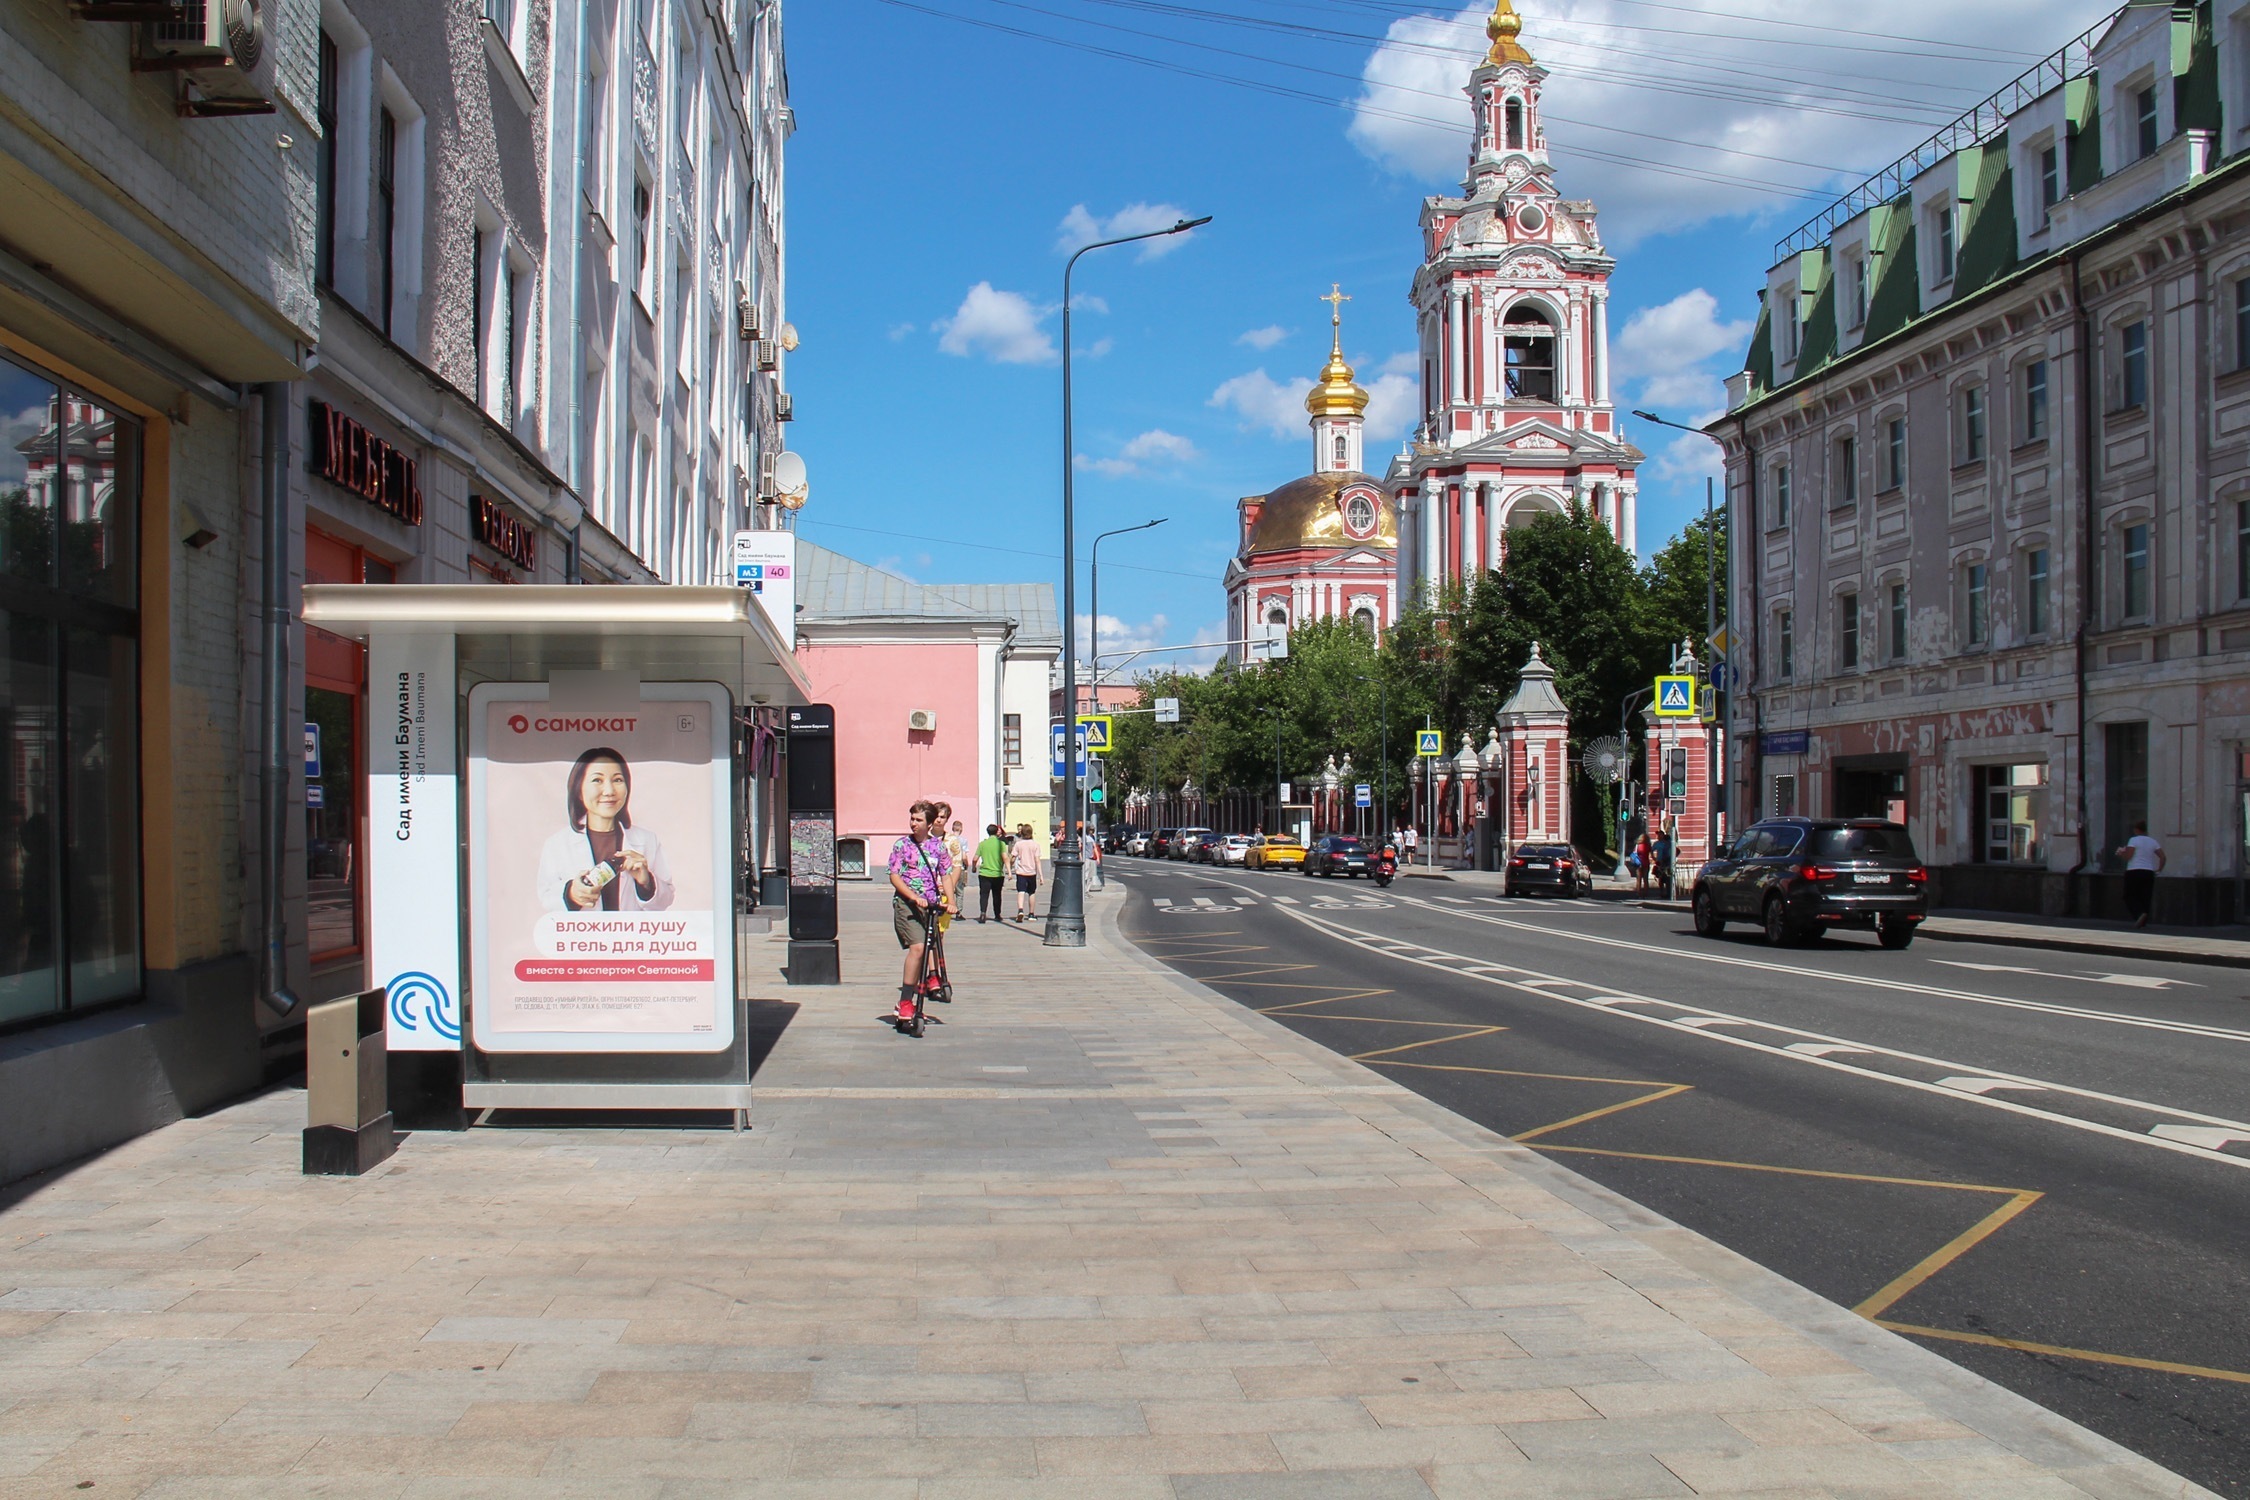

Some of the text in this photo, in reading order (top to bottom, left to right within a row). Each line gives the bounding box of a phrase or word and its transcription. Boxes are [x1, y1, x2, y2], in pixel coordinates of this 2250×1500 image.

[320, 402, 423, 526] МЕБЕЛЬ
[477, 495, 536, 572] VERONA
[770, 567, 784, 577] 40
[416, 672, 425, 783] Sad Imeni Baumana
[534, 718, 637, 732] самокат
[681, 717, 692, 729] 6+
[396, 672, 412, 841] Сад имени Баумана
[556, 921, 687, 935] вложили душу
[556, 941, 697, 955] в гель для душа
[576, 967, 635, 977] экспертом
[637, 964, 698, 975] Светланой
